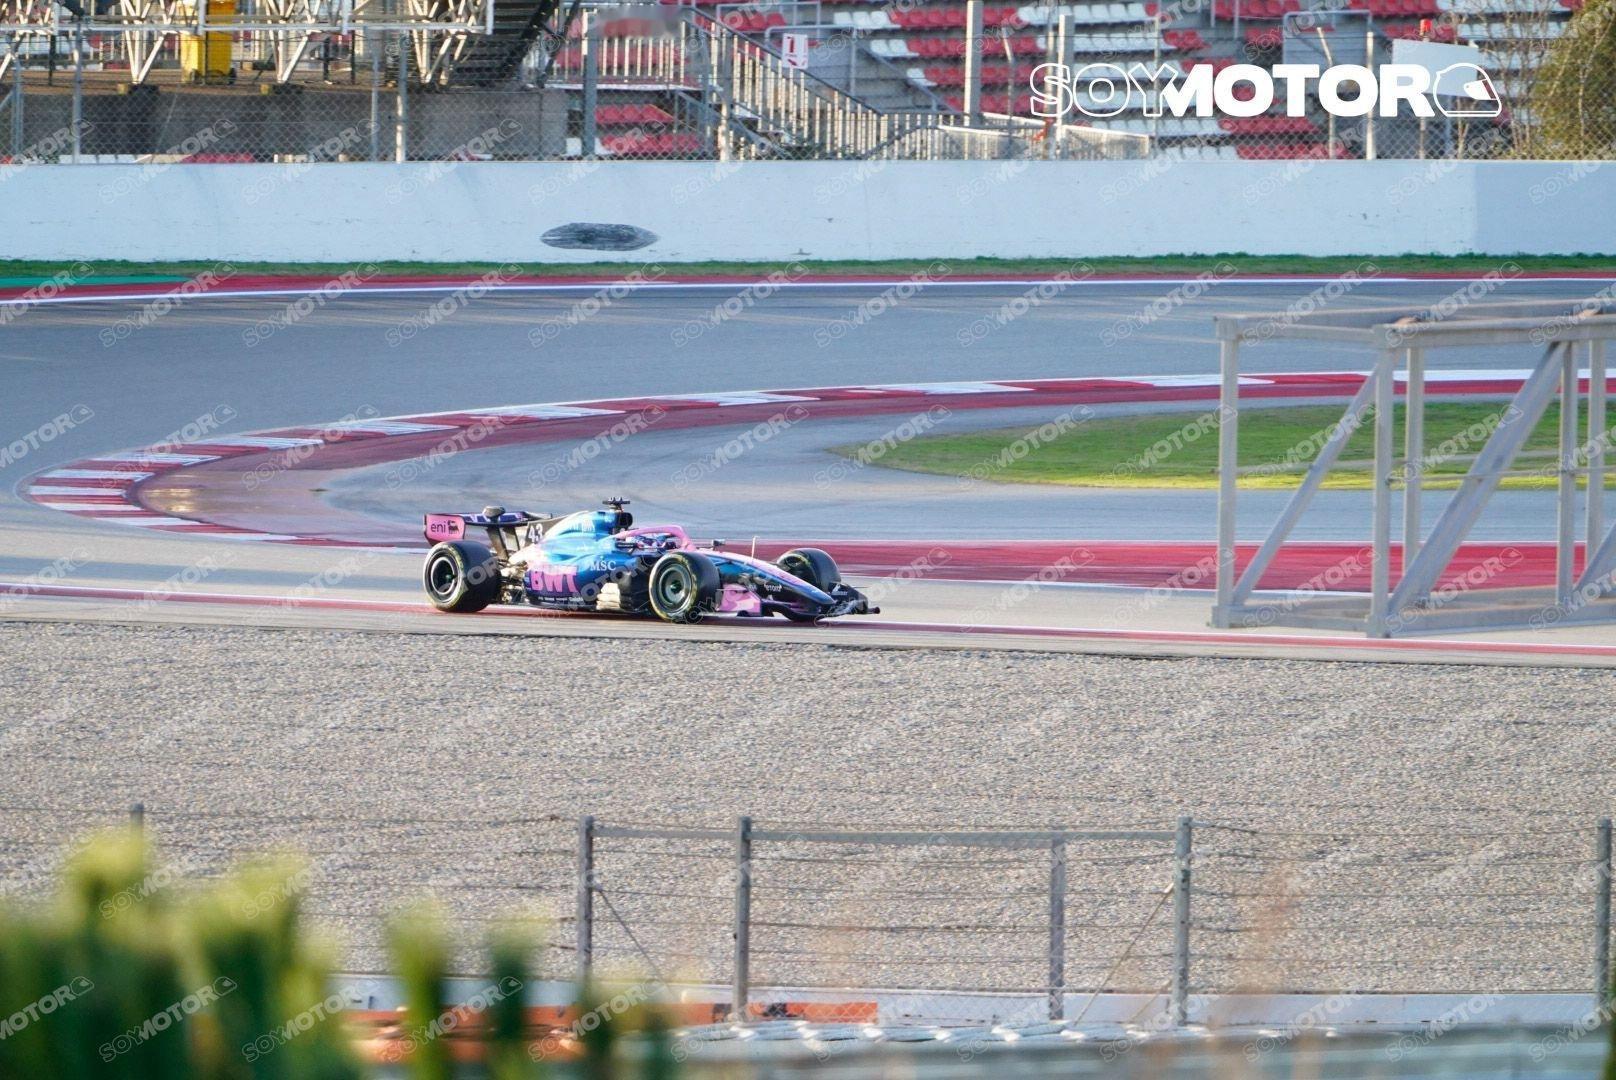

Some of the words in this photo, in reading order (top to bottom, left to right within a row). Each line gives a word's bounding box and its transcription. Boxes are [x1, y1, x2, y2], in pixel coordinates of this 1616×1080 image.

[430, 520, 446, 532] eni
[528, 523, 543, 543] 43
[590, 561, 616, 571] MSC
[530, 564, 579, 592] BWT
